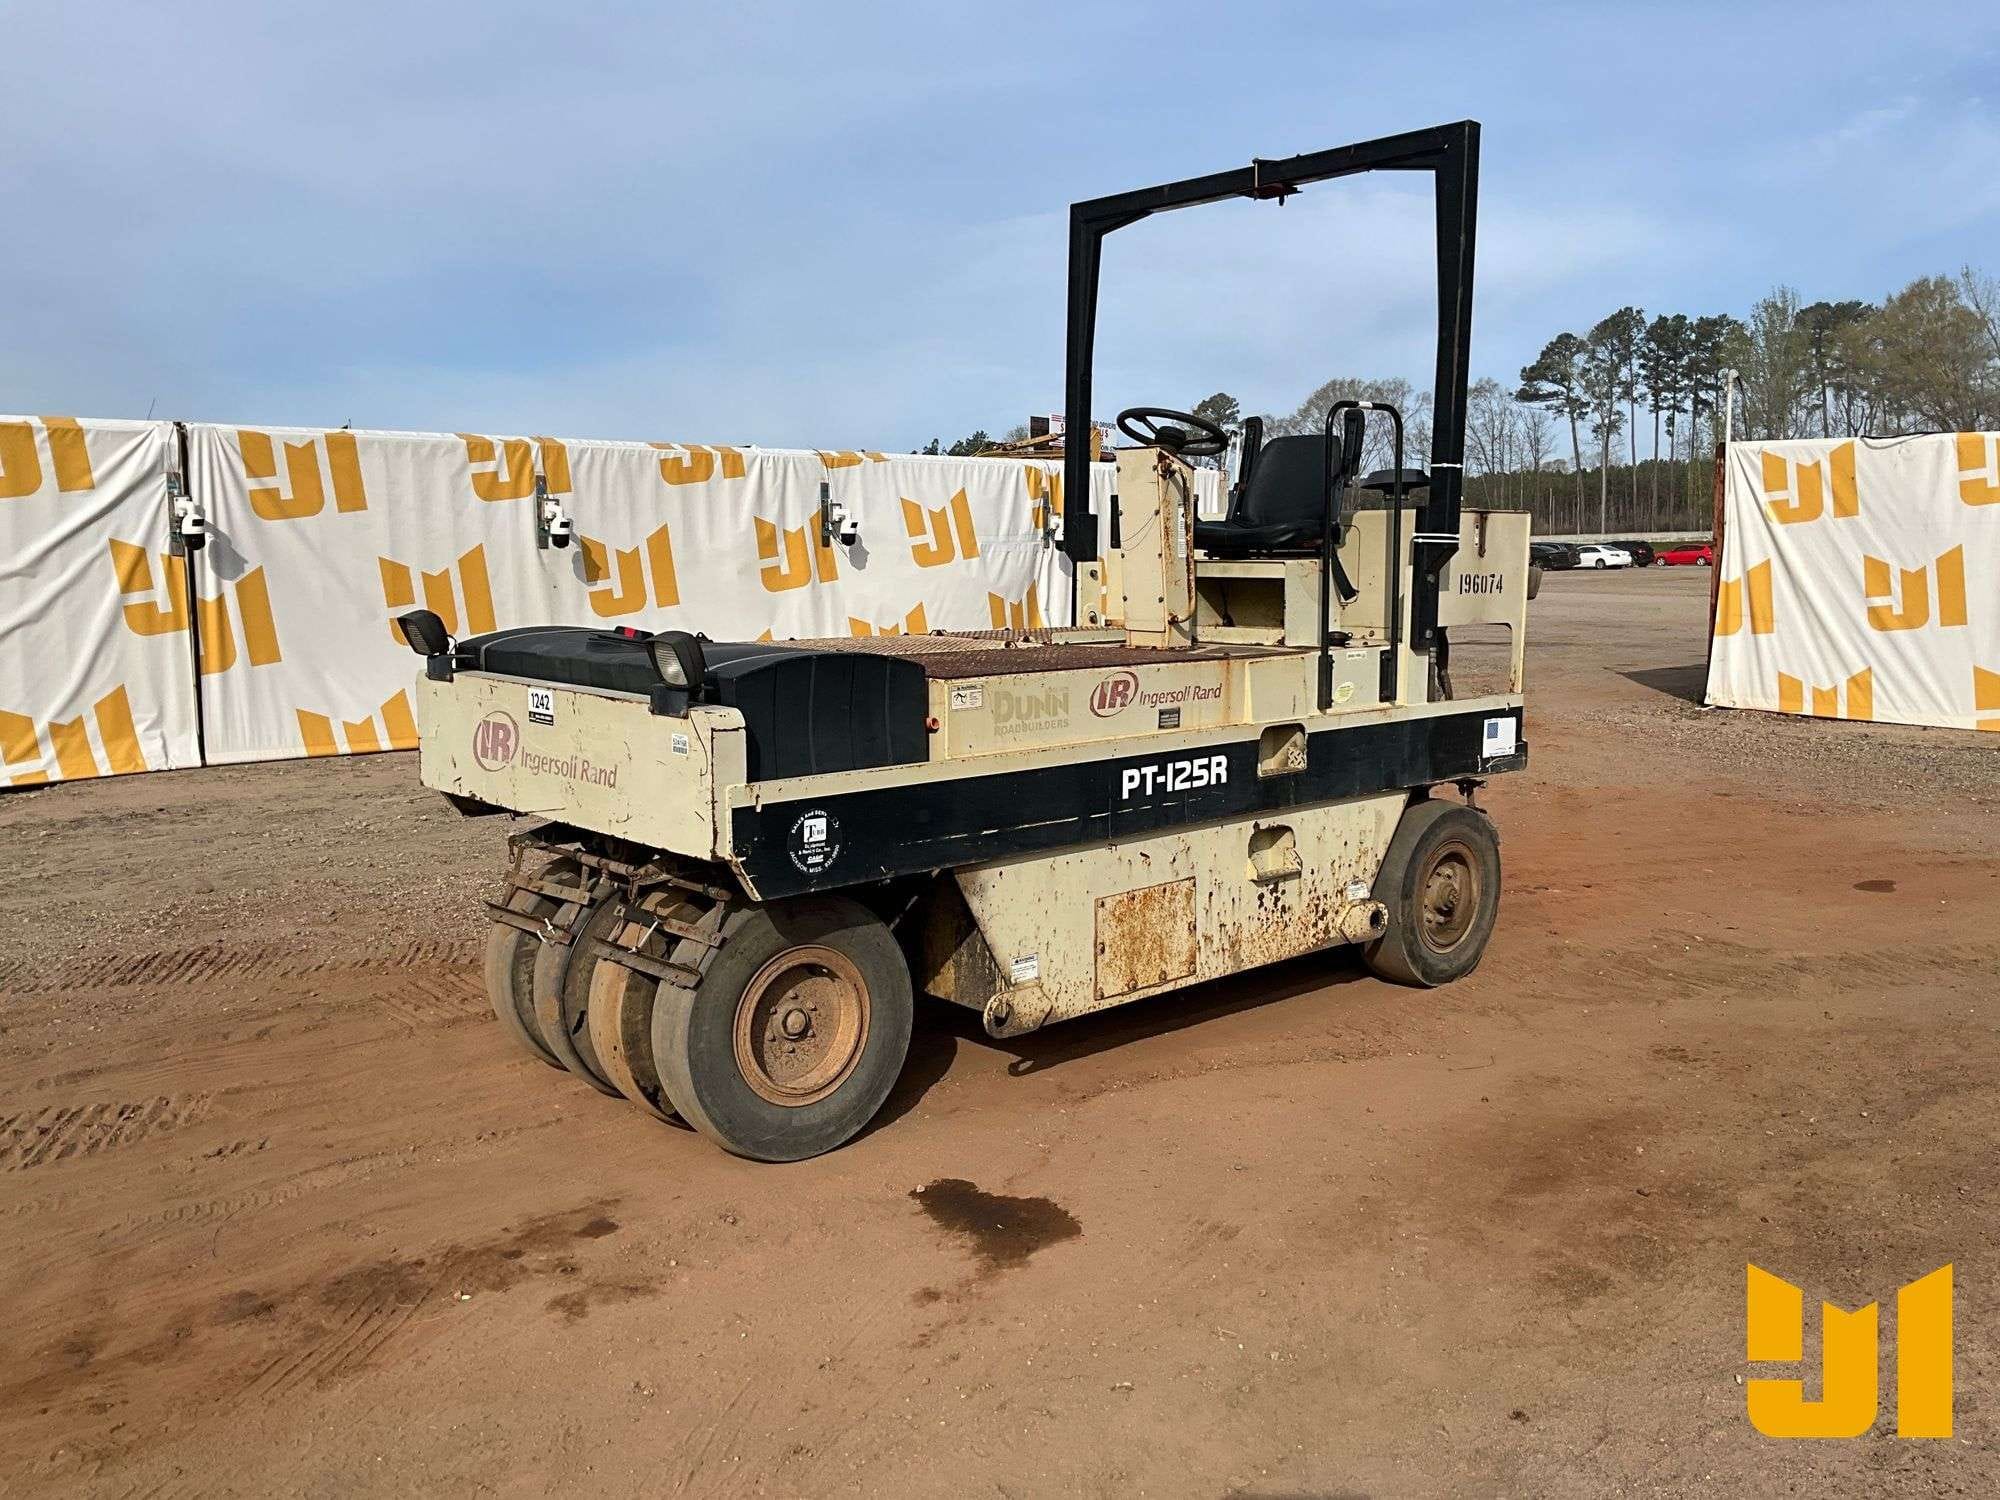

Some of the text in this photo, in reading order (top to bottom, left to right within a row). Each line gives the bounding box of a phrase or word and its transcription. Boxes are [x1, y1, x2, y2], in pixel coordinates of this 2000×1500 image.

[1459, 573, 1503, 595] 196074
[531, 692, 550, 711] 1242
[993, 687, 1070, 724] DUNN
[1139, 685, 1191, 708] Ingersoll
[1193, 682, 1223, 701] Rand
[993, 718, 1070, 737] ROADBUILDERS
[520, 746, 577, 779] Ingersoll
[580, 760, 618, 789] Rand
[1121, 755, 1229, 800] PT-125R
